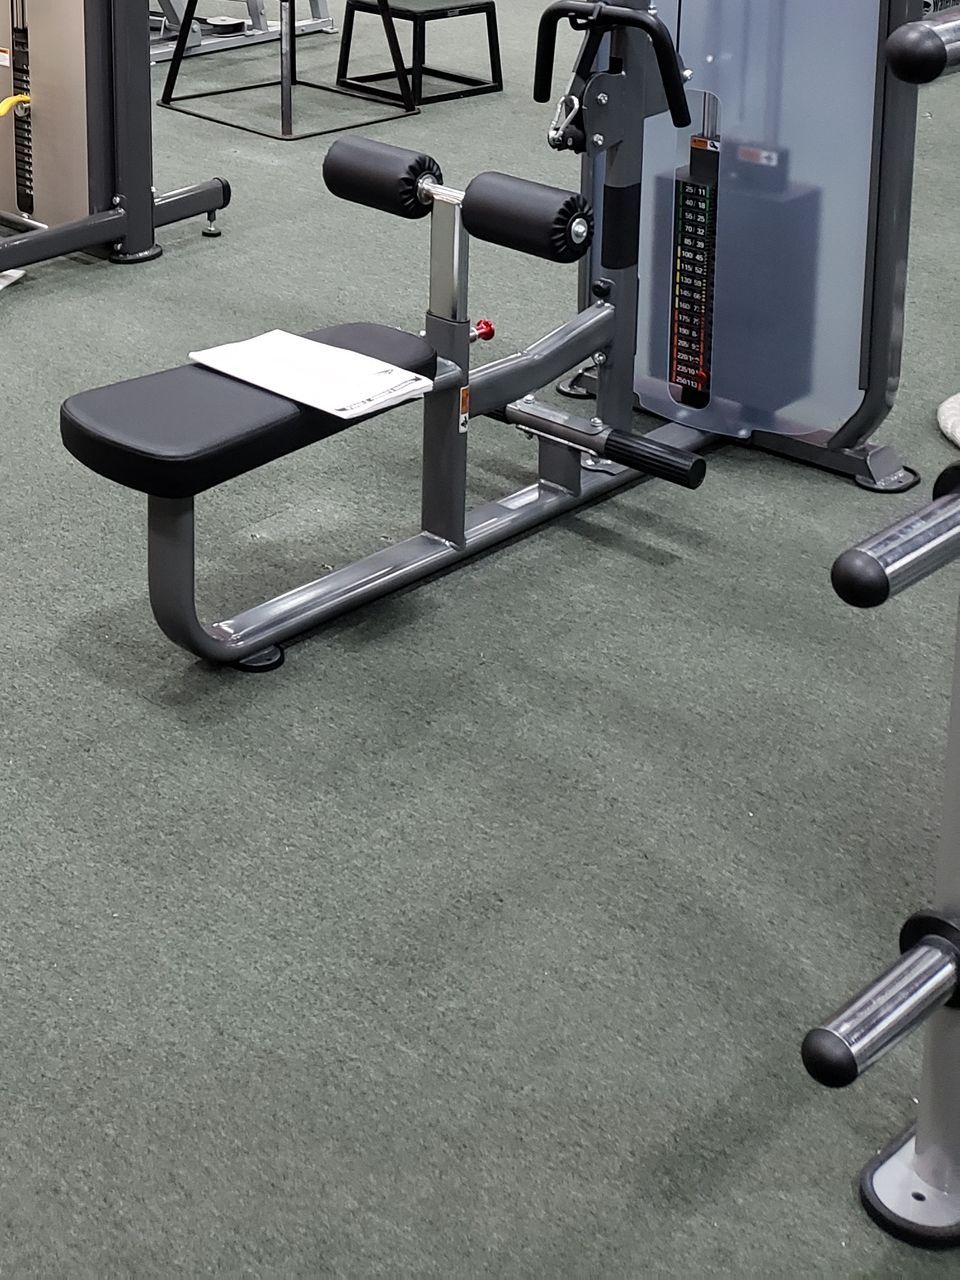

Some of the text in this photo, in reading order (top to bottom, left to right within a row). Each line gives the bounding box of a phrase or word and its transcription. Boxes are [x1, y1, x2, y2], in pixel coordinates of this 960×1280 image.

[698, 188, 705, 196] 11
[697, 215, 705, 223] 25
[696, 228, 705, 236] 32
